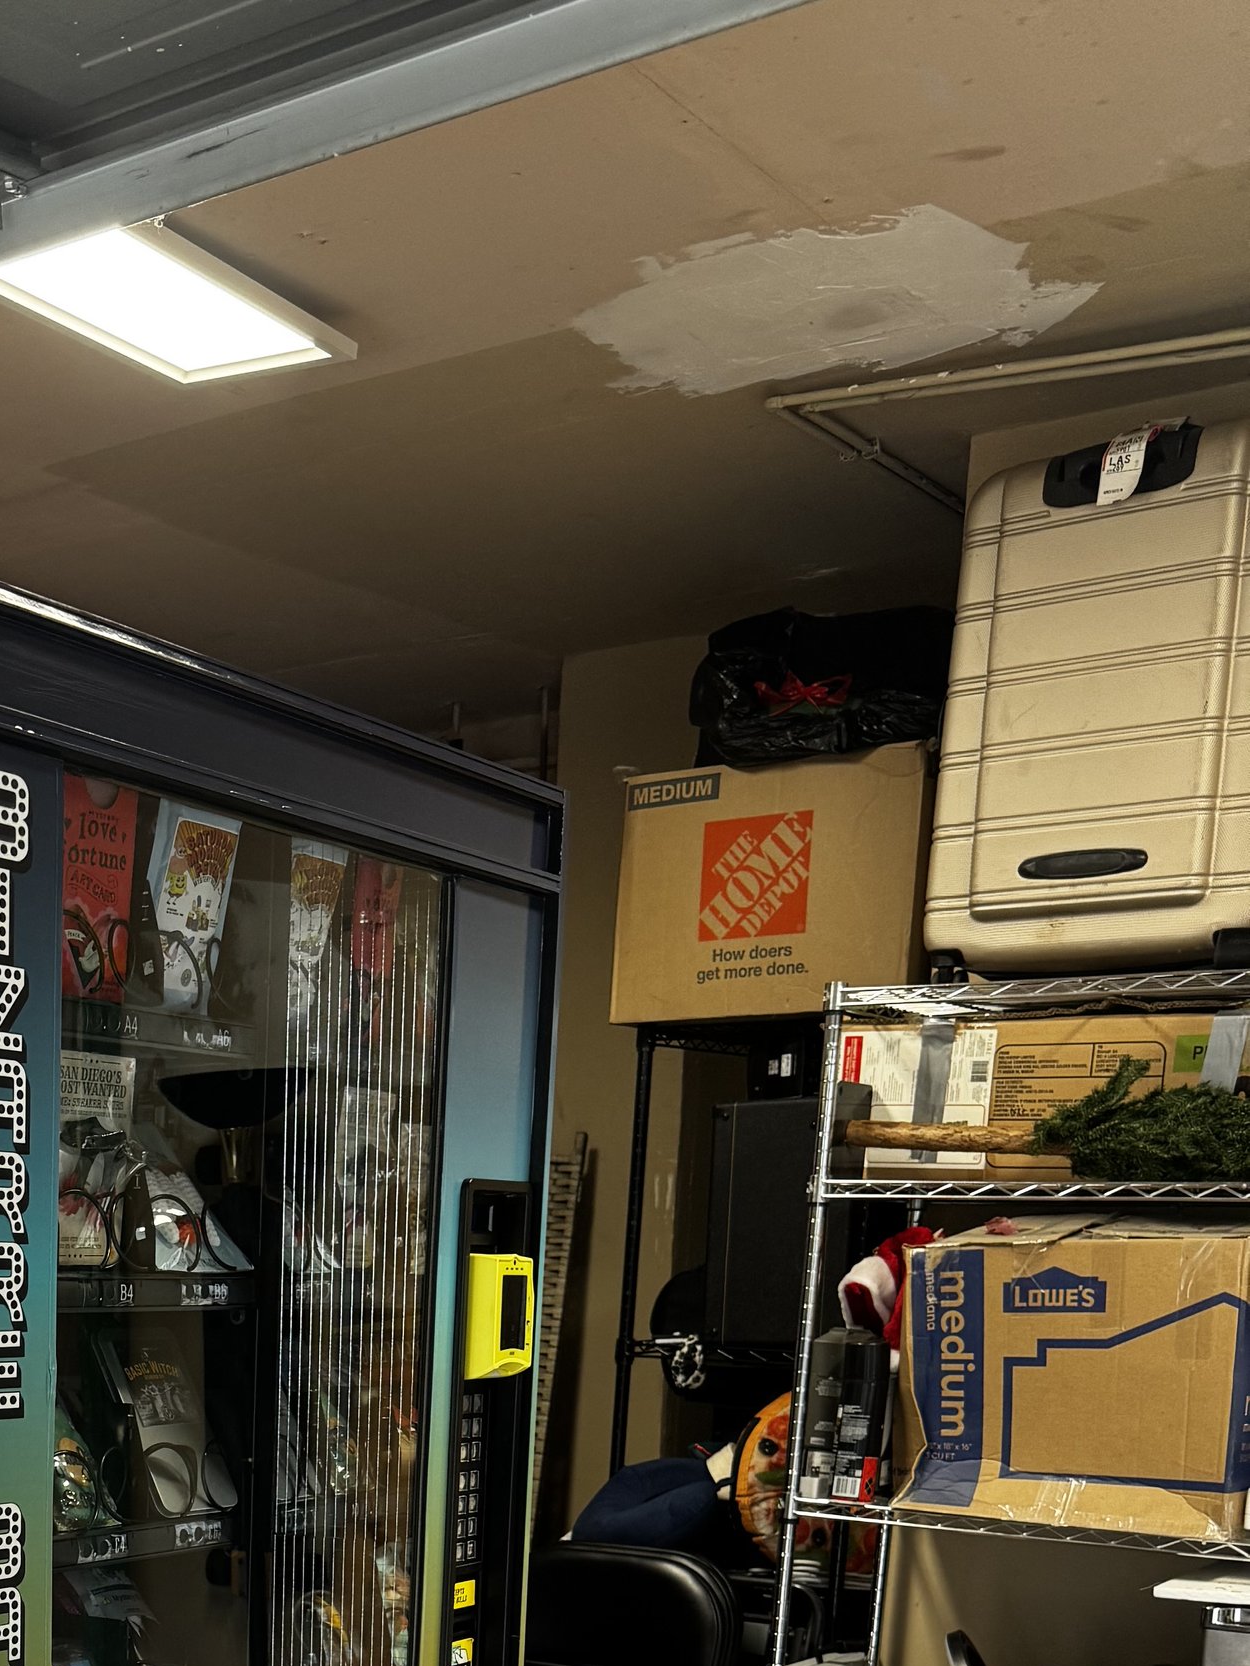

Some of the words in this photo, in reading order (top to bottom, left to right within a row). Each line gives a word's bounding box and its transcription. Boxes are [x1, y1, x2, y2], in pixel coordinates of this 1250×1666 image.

[1109, 454, 1131, 468] LAS
[633, 778, 713, 806] MEDIUM
[65, 844, 127, 871] ortune
[711, 830, 758, 880] THE
[700, 812, 812, 940] HOME
[739, 855, 809, 938] DEPOT
[712, 949, 745, 962] How
[749, 946, 792, 959] doers
[697, 967, 720, 984] get
[724, 966, 762, 979] more
[766, 962, 808, 975] done.
[123, 1015, 138, 1034] A4
[81, 1067, 122, 1084] DIEGO'S
[61, 1080, 80, 1094] OST
[82, 1082, 127, 1099] WANTED
[120, 1284, 134, 1301] B4
[925, 1271, 936, 1331] mediana
[1014, 1285, 1095, 1307] LOWE'S
[940, 1270, 975, 1437] medium
[124, 1362, 150, 1381] BASIC
